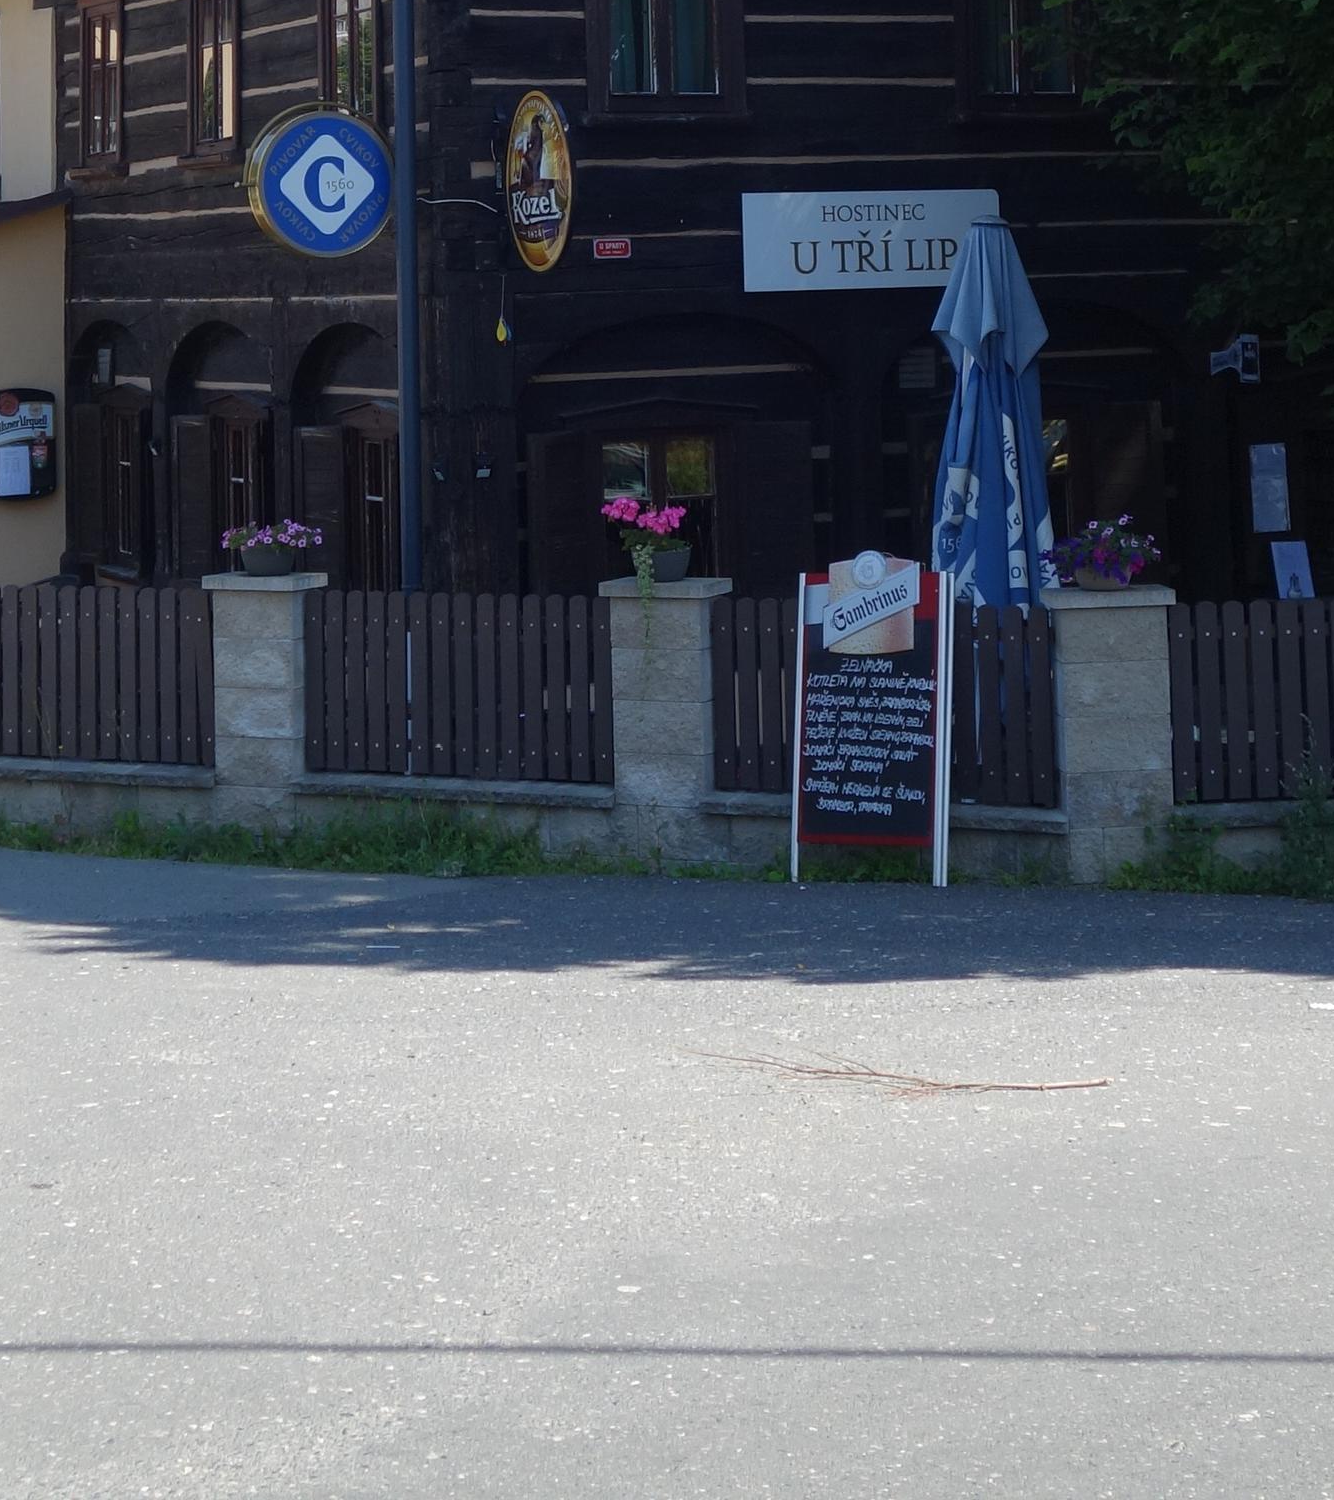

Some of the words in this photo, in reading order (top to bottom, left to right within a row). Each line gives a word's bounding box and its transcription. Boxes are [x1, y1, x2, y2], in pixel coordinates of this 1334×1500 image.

[269, 125, 316, 176] PIVOVAR
[338, 127, 380, 168] CVIKOV
[303, 155, 346, 213] C
[326, 179, 355, 193] 1560
[274, 200, 316, 242] CVIKOV
[339, 193, 385, 243] PIVOVAR
[511, 187, 561, 225] Kozel
[821, 203, 926, 222] HOSTINEC
[789, 241, 820, 275] U
[831, 230, 894, 274] TŘÍ
[904, 238, 959, 271] LIP
[19, 414, 48, 431] Urquell
[832, 584, 908, 631] Gambrinus
[806, 672, 848, 688] KOTLETA
[849, 675, 866, 688] NA
